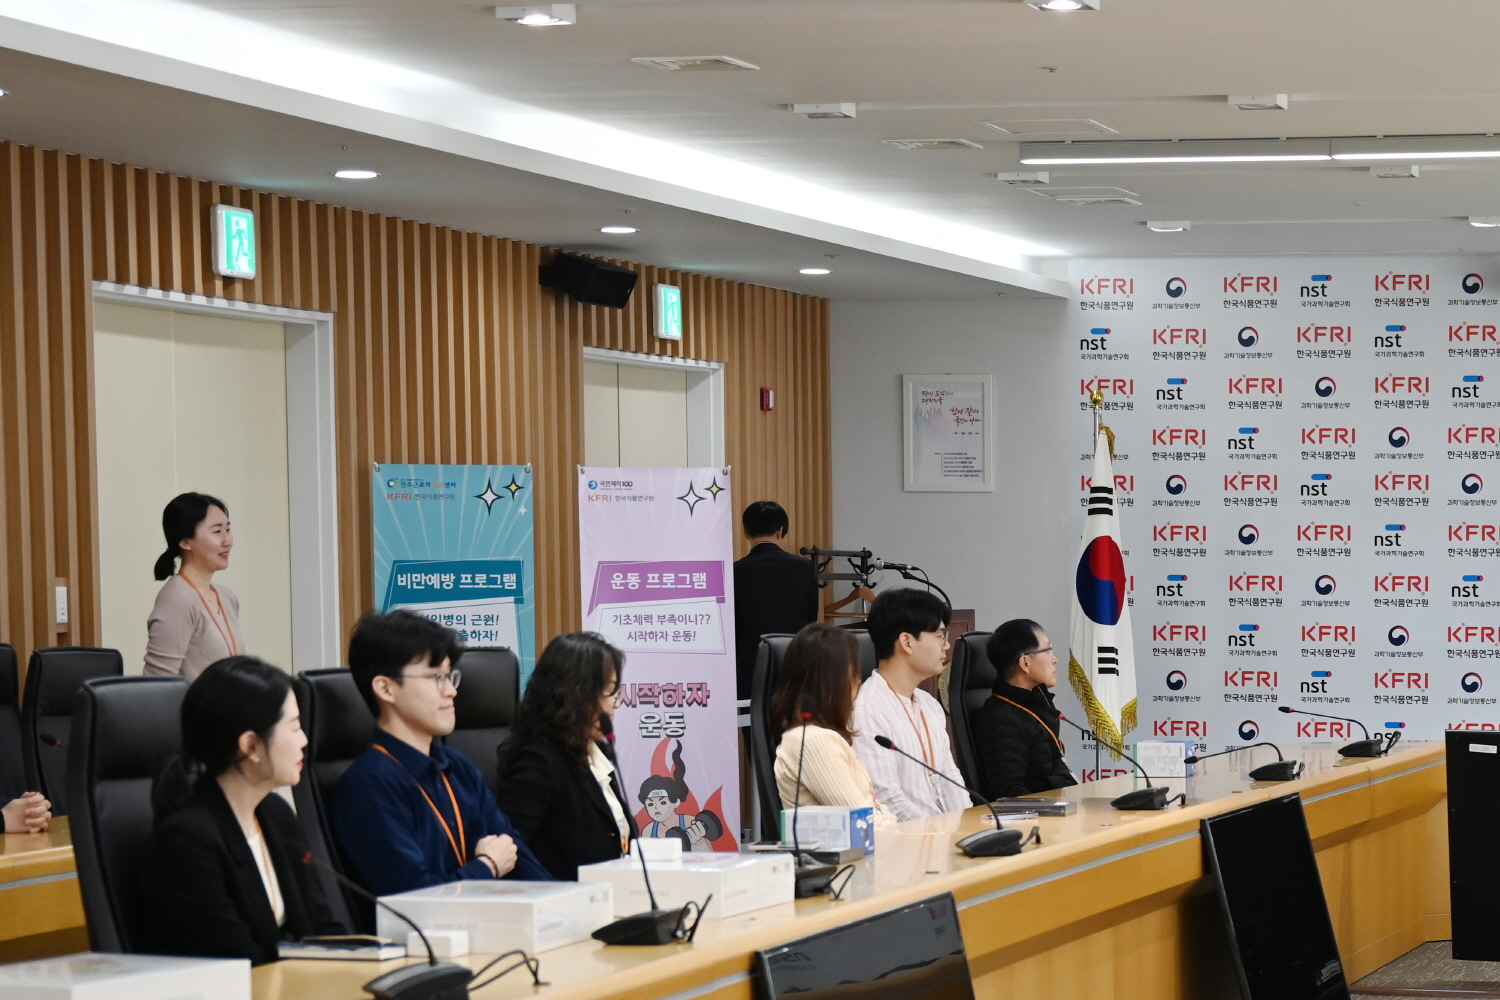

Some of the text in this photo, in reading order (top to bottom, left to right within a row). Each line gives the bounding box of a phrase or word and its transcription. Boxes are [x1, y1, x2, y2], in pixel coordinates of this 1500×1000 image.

[1224, 277, 1277, 291] KFRI
[1152, 302, 1201, 310] 과학기술정보통신부
[1223, 300, 1278, 308] 한국식품연구원
[1080, 337, 1106, 350] nst
[1080, 353, 1129, 361] 국가과학기술연구회
[1452, 385, 1479, 398] nst
[1153, 429, 1206, 444] KFRI
[1151, 452, 1206, 460] 한국식품연구원
[1375, 475, 1429, 490] KFRI
[414, 493, 456, 501] 한국식품연구원
[588, 494, 612, 502] KFRI
[1374, 498, 1429, 506] 한국식품연구원
[397, 573, 517, 590] 비만예방 프로그램
[610, 572, 707, 590] 운동 프로그램
[422, 614, 499, 626] 인병의 근원!
[612, 614, 711, 626] 기초체력 부족이니??
[458, 629, 498, 642] 출하자!
[627, 630, 696, 642] 시작하자 운동!
[1225, 671, 1278, 686] KFRI
[620, 682, 710, 708] 시작하자
[1152, 695, 1201, 703] 과학기술정보통신부
[1223, 694, 1278, 702] 한국식품연구원
[638, 712, 686, 738] 운동
